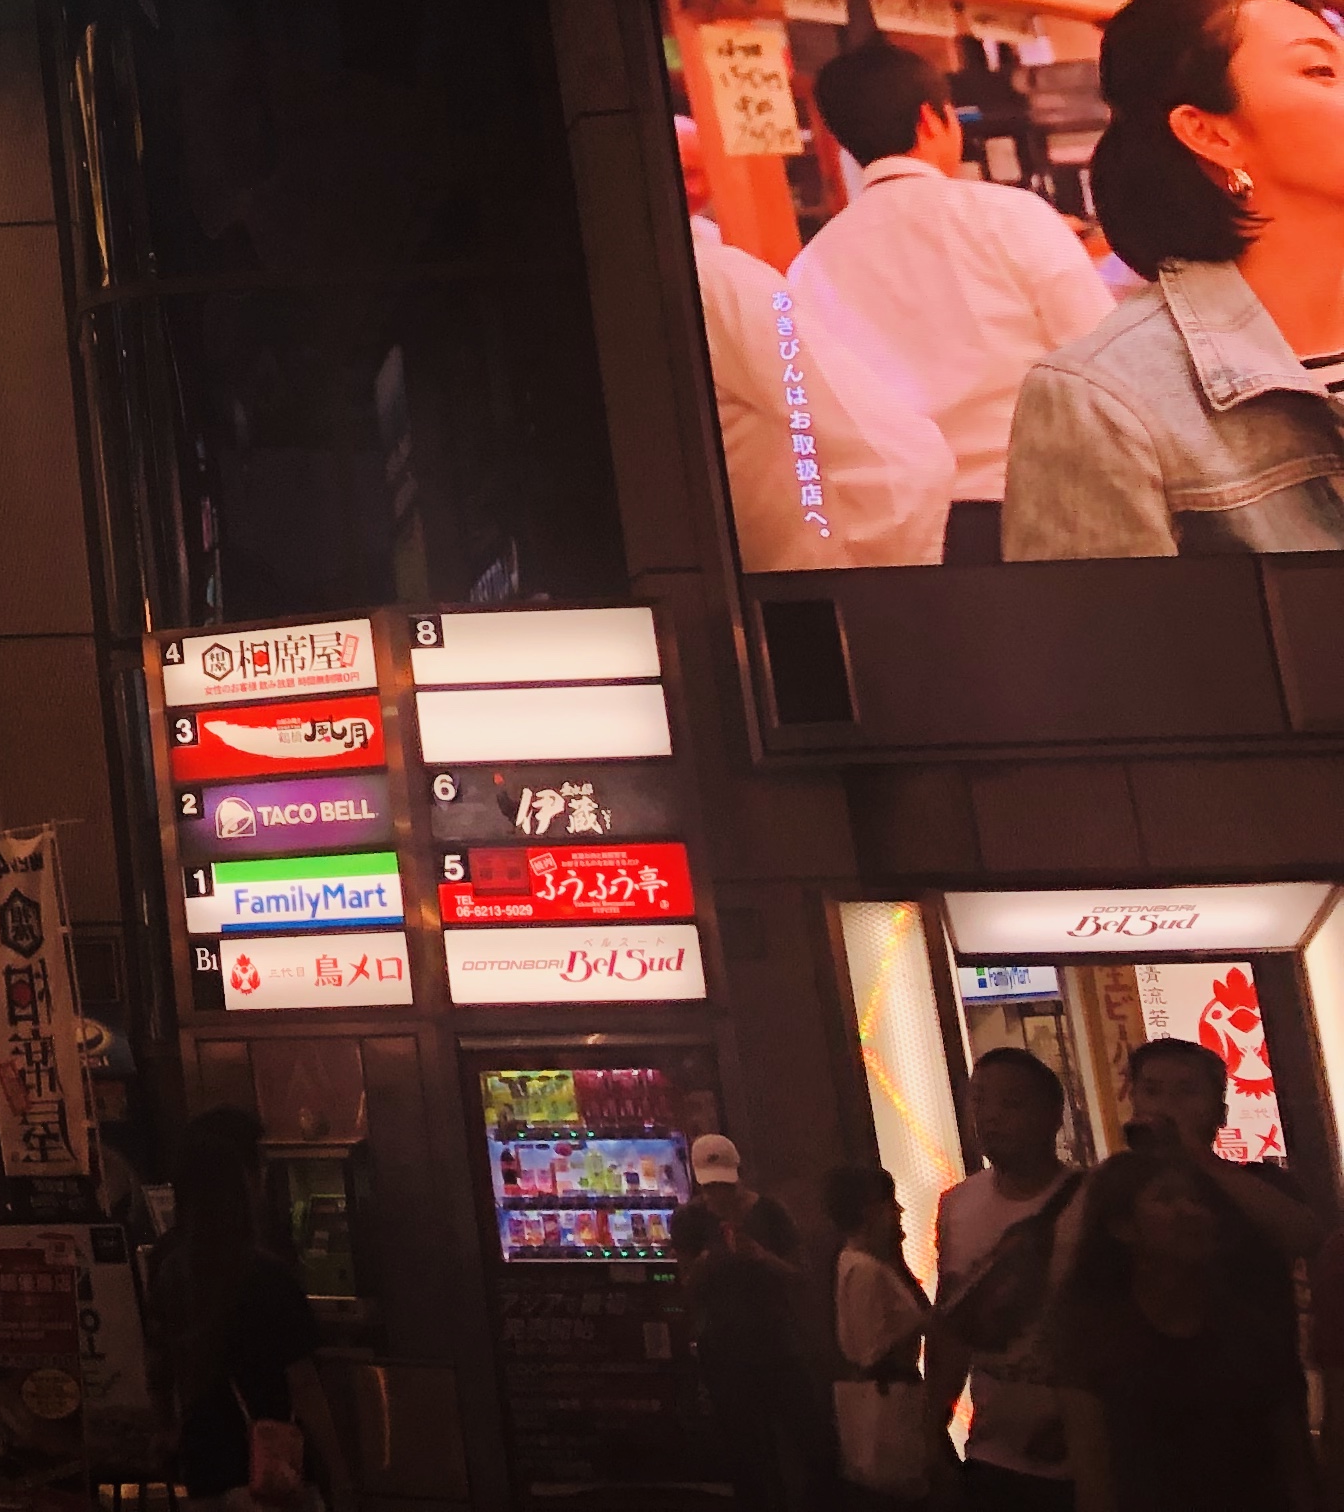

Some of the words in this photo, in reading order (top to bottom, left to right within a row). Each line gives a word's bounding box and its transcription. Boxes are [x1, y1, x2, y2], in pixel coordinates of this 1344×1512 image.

[416, 622, 438, 646] 8
[165, 642, 181, 663] 4
[235, 631, 346, 678] 相席屋
[174, 719, 194, 743] 3
[433, 773, 456, 802] 6
[182, 793, 197, 815] 2
[258, 805, 316, 826] TACO
[320, 799, 377, 822] BELL
[444, 855, 465, 881] 5
[193, 872, 206, 895] 1
[536, 865, 668, 904] ふうふう亭
[234, 881, 388, 918] FamilyMart
[455, 895, 475, 906] TEL
[456, 904, 533, 918] 06-6213-5029
[1092, 904, 1196, 913] DOTONBORI
[1066, 915, 1131, 937] Bel
[1124, 913, 1200, 936] Sud
[583, 936, 665, 948] ベルスード
[269, 966, 305, 978] 三代目
[315, 954, 402, 987] 鳥メロ
[462, 960, 564, 971] DOTONBORI
[560, 948, 618, 982] Bel
[616, 948, 685, 981] Sud
